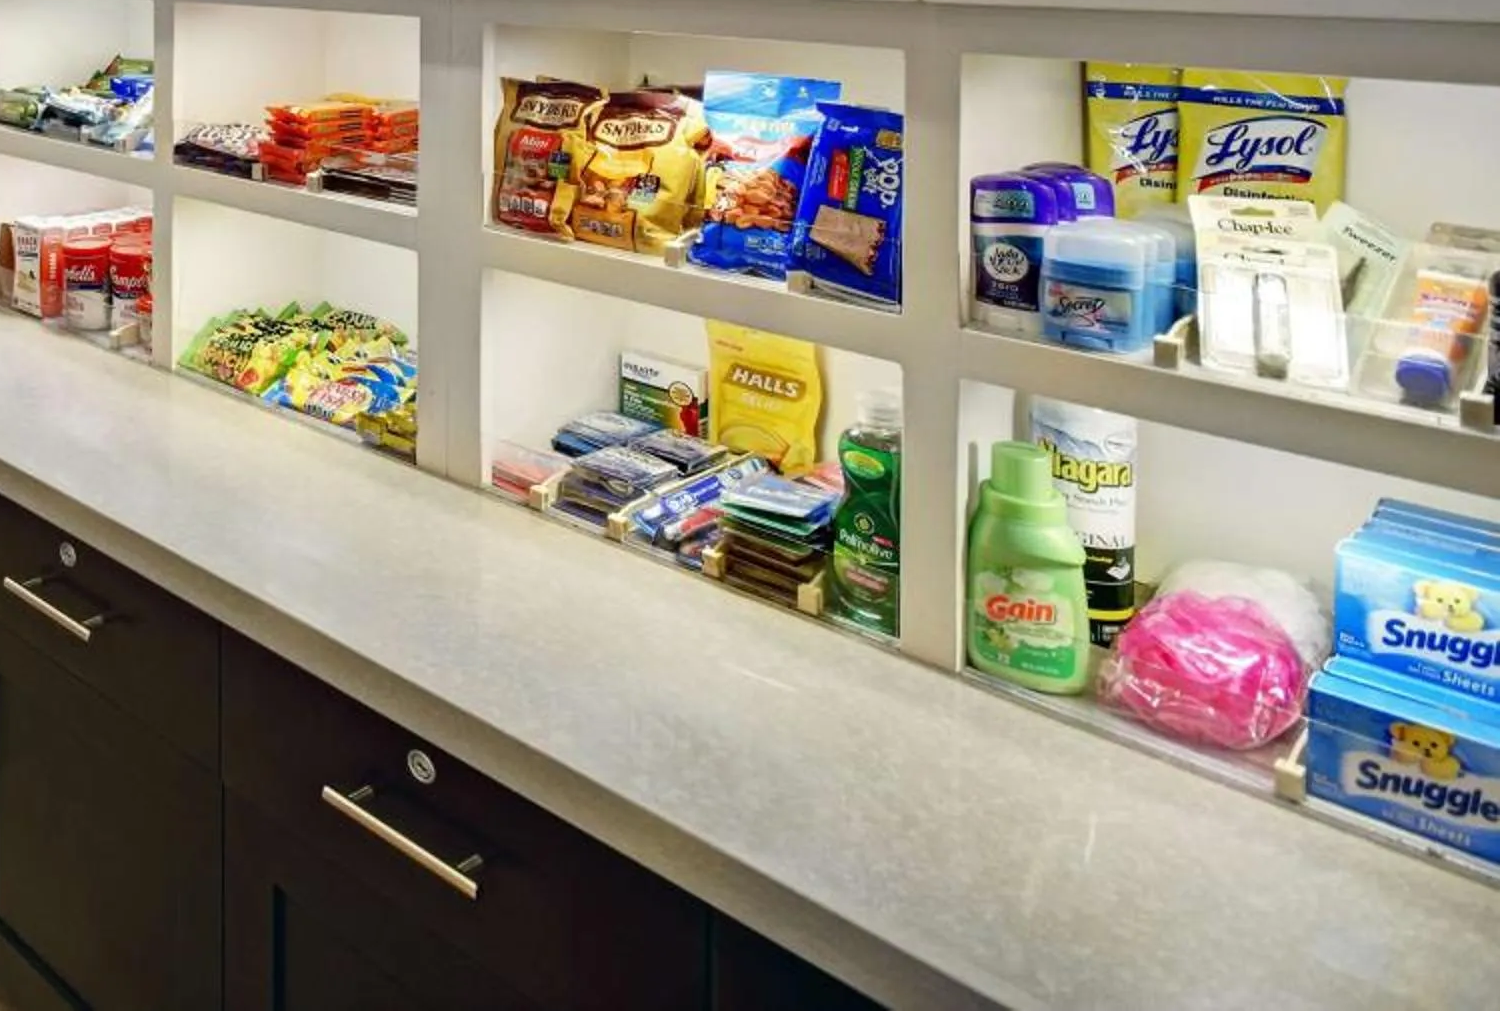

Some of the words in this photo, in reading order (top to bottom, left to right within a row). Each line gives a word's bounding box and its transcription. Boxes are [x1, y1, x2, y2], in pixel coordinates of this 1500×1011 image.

[1205, 125, 1315, 170] Lysol
[732, 366, 800, 399] HALLS
[985, 595, 1056, 623] Gain
[1442, 670, 1496, 697] Sheets
[1355, 759, 1500, 823] Snuggle
